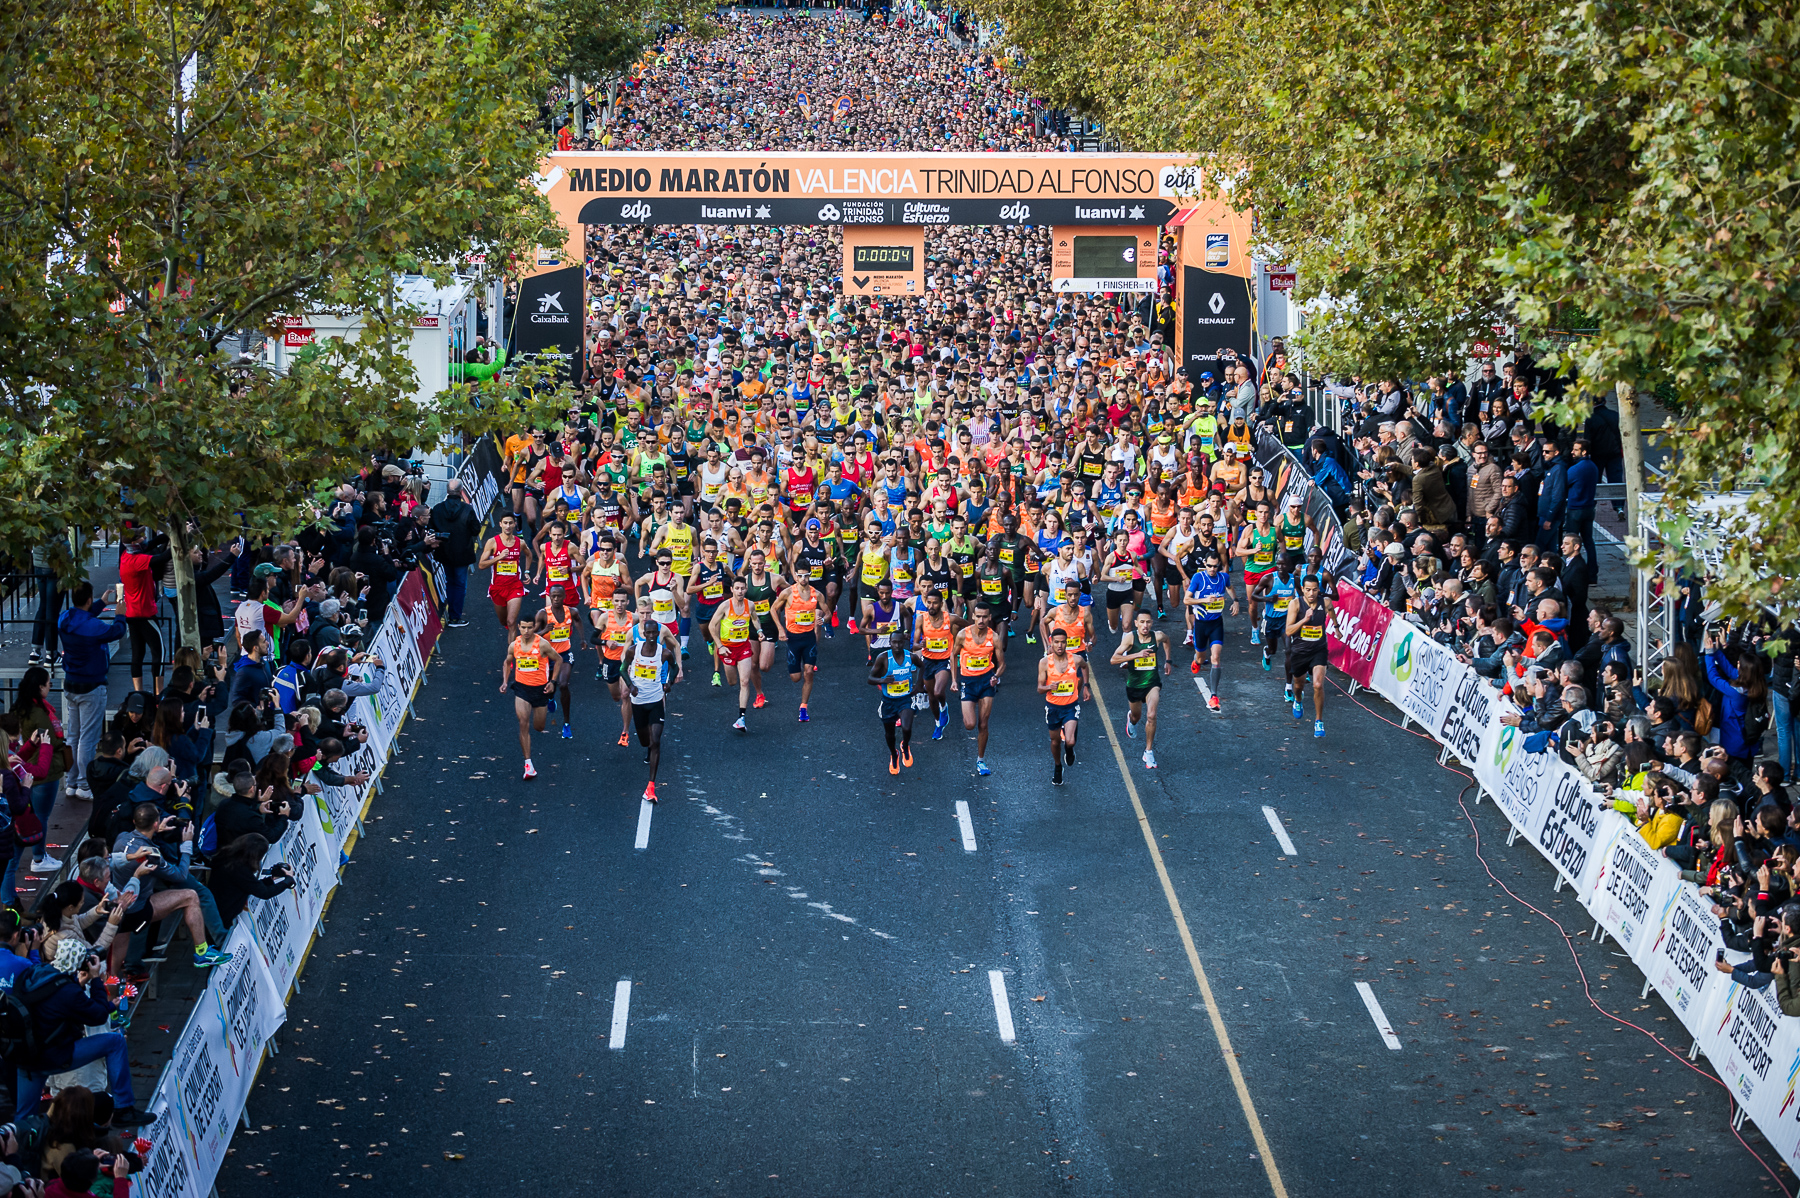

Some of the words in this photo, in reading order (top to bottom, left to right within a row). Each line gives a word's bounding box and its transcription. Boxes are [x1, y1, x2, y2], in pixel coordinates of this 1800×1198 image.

[569, 168, 651, 192] MEDIO
[660, 162, 790, 193] MARATÓN
[795, 168, 918, 194] VALENCIA
[920, 168, 1034, 194] TRINIDAD
[1037, 168, 1155, 194] ALFONSO
[620, 200, 652, 222] edp
[701, 204, 751, 218] luanvi
[843, 208, 884, 216] TRINIDAD
[902, 213, 950, 224] Esfuerzo
[904, 202, 940, 213] Cultura
[999, 205, 1030, 223] edp
[1075, 205, 1125, 219] luanvi
[1123, 247, 1135, 262] €
[531, 315, 569, 324] CaixaBank
[1454, 672, 1489, 723] Cultura
[1555, 772, 1592, 830] Cultura
[1540, 809, 1587, 880] Esfuerzo
[1612, 844, 1653, 896] COMUNITAT
[1606, 870, 1622, 896] DE
[1618, 880, 1650, 925] L'ESPORT
[1672, 906, 1713, 962] COMUNITAT
[1665, 933, 1680, 960] DE
[1674, 942, 1708, 993] L'ESPORT
[1737, 986, 1778, 1048] COMUNITAT
[1730, 1014, 1744, 1045] DE
[1738, 1025, 1773, 1082] L'ESPORT
[184, 1041, 212, 1114] COMUNITAT
[194, 1106, 206, 1142] DE
[200, 1064, 224, 1126] L'ESPORT
